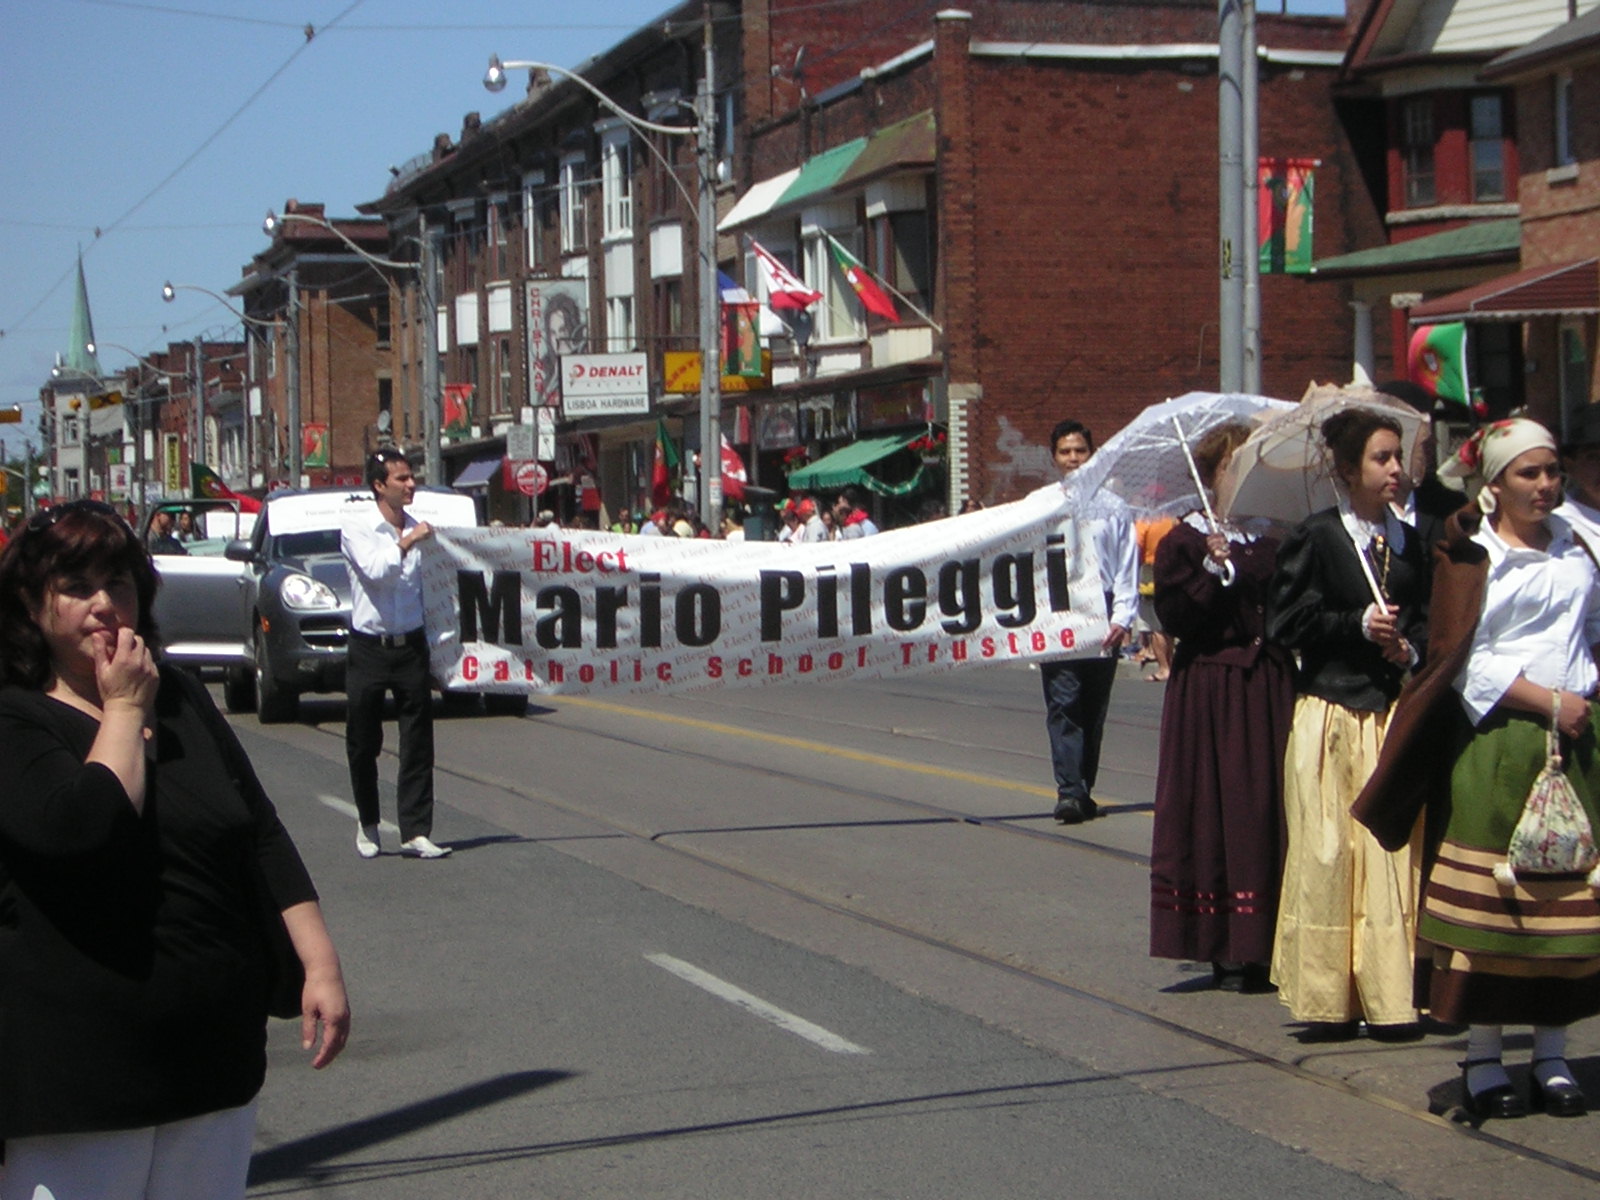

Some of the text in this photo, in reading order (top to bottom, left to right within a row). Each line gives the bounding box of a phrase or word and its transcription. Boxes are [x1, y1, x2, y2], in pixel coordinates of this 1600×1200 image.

[589, 365, 644, 378] DENALT
[567, 397, 646, 410] LISBOA HARDWARE
[530, 540, 630, 574] Elect
[457, 533, 1071, 649] Mario Pileggi
[462, 655, 672, 683] Catholic
[706, 645, 867, 679] School
[900, 627, 1075, 666] Trustee
